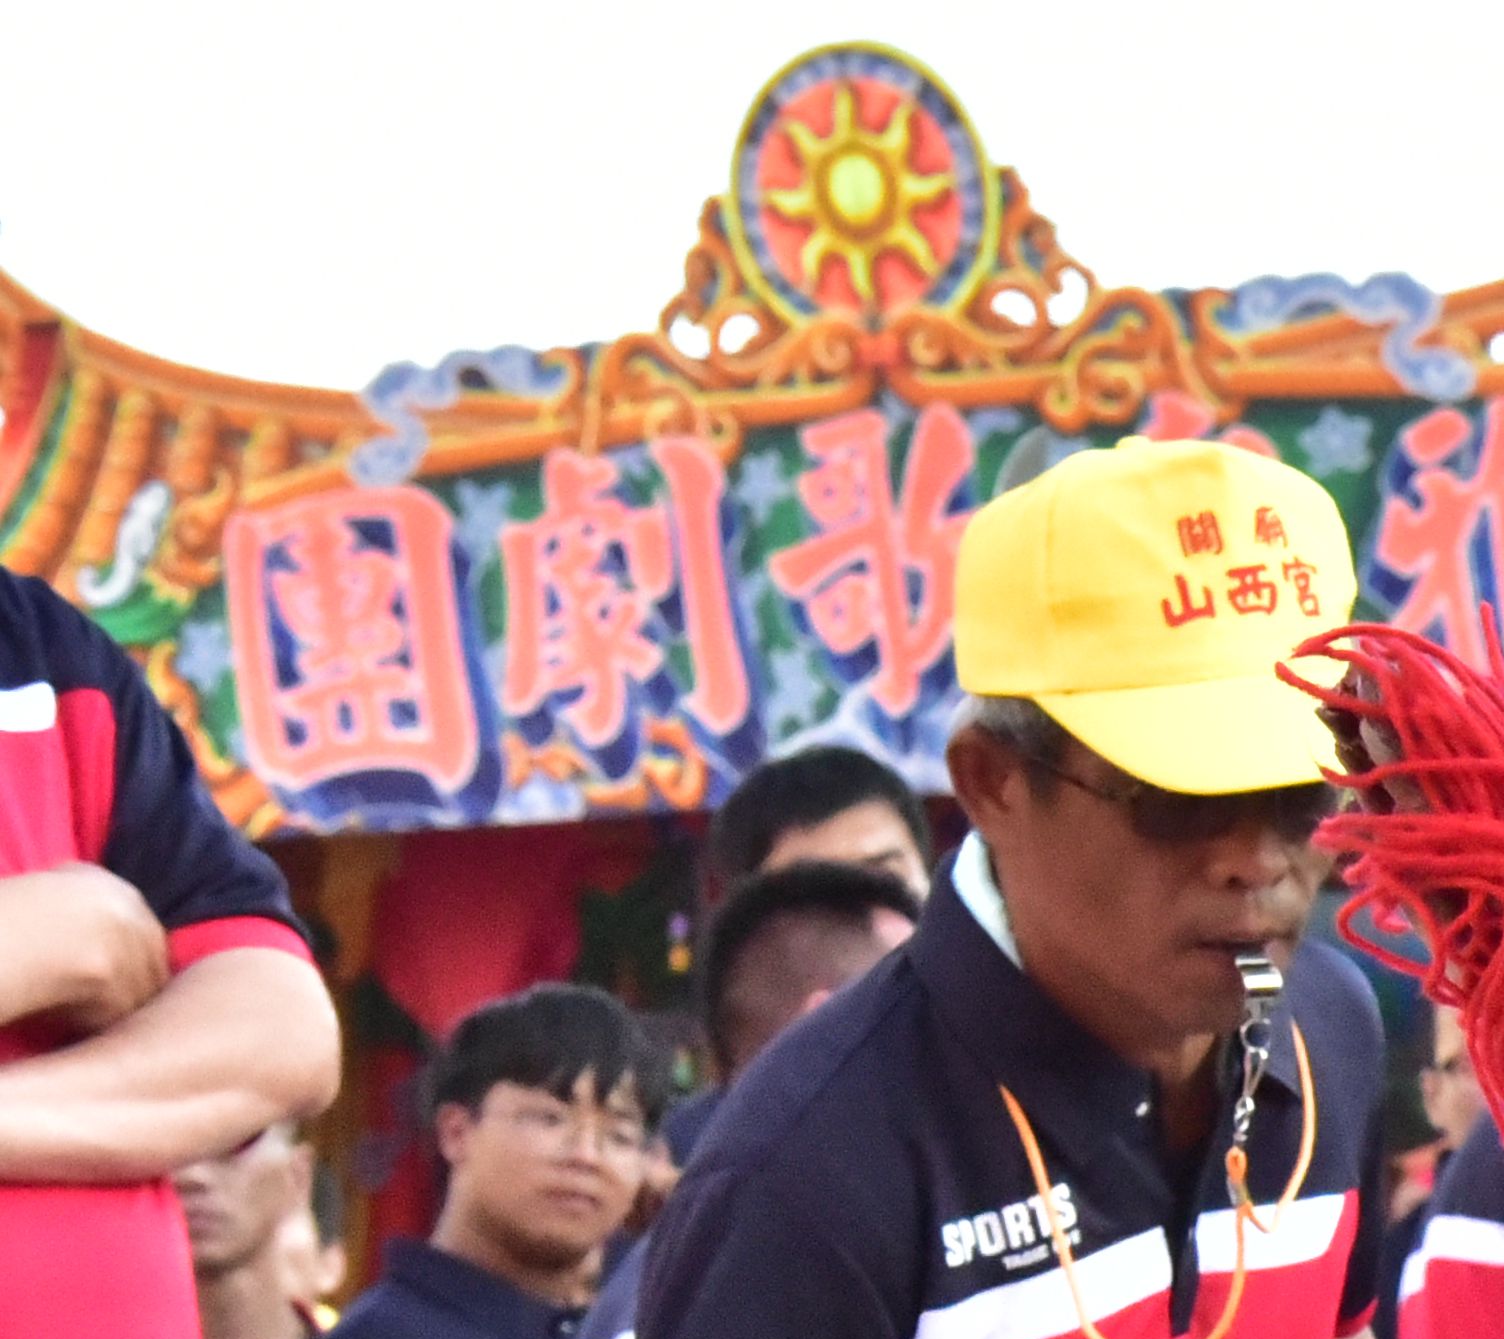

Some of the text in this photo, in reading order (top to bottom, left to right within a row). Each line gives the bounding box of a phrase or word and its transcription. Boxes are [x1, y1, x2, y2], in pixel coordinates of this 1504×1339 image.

[1161, 556, 1320, 628] 山西宮
[941, 1182, 1077, 1268] SPORTS
